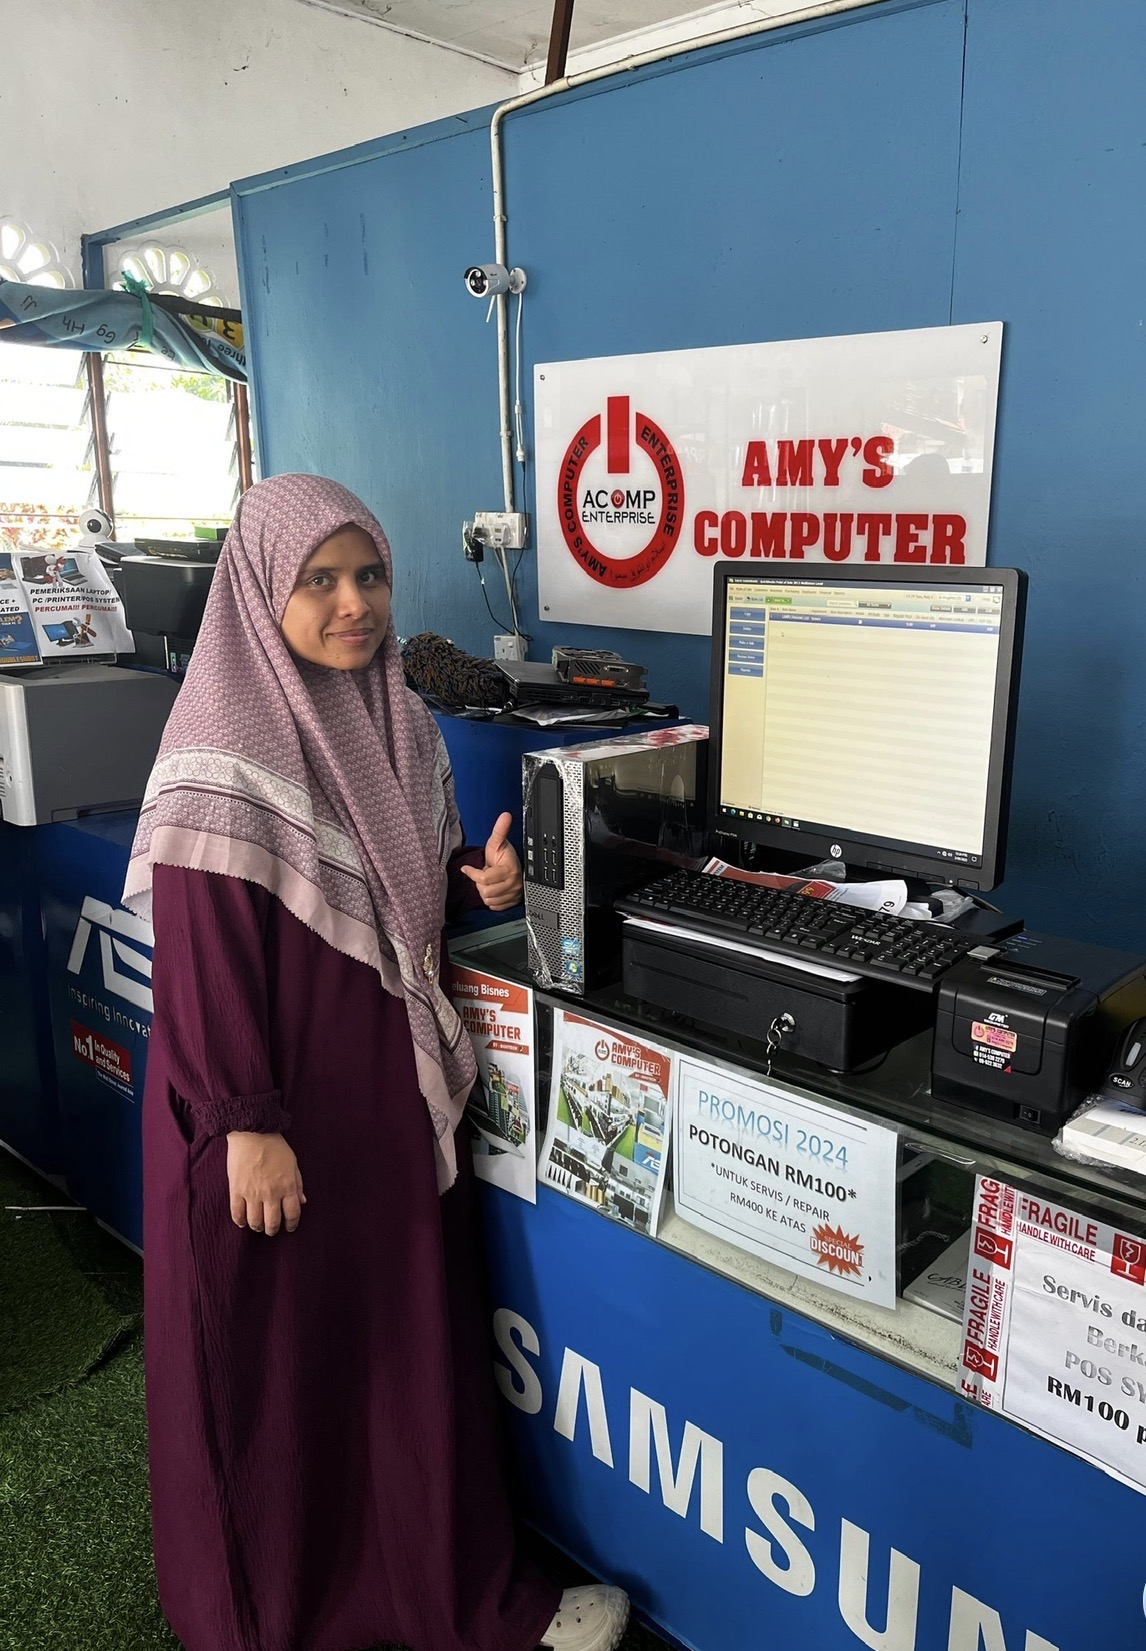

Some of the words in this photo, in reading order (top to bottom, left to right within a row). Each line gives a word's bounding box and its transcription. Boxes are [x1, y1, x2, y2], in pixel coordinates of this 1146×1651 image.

[62, 315, 85, 335] Hh
[97, 323, 116, 344] Gg
[640, 425, 678, 537] ENTERPRISE
[742, 436, 895, 489] AMY'S
[563, 436, 589, 534] COMPUTER
[582, 511, 655, 524] ENTERPRISE
[693, 510, 967, 565] COMPUTER
[573, 536, 608, 577] AMY'S
[30, 587, 85, 595] PEMERIKSAAN
[452, 981, 479, 996] eluang
[480, 984, 510, 998] Bisnes
[67, 982, 111, 1022] Inspiring
[113, 1005, 151, 1039] Innovat
[463, 1006, 497, 1022] AMY'S
[463, 1021, 522, 1040] COMPUTER
[100, 1044, 120, 1066] Quality
[611, 1054, 661, 1075] COMPUTER
[612, 1041, 641, 1058] AMY'S
[106, 1059, 130, 1083] Services
[1112, 1076, 1132, 1088] SCAN
[698, 1090, 789, 1145] PROMOSI
[796, 1129, 849, 1167] 2024
[689, 1124, 780, 1177] POTONGAN
[730, 1191, 764, 1215] RM400
[765, 1207, 778, 1222] KE
[780, 1214, 807, 1233] ATAS
[750, 1180, 783, 1203] SERVIS
[793, 1197, 830, 1222] REPAIR
[1016, 1220, 1049, 1243] HANDLE
[1049, 1233, 1071, 1251] WITH
[1071, 1242, 1096, 1263] CARE
[967, 1268, 991, 1346] FRAGILE
[994, 1278, 1006, 1301] CARE
[1043, 1274, 1112, 1319] Servis
[990, 1299, 1001, 1321] WITH
[987, 1319, 1000, 1352] HANDLE
[1065, 1350, 1112, 1387] POS
[1047, 1375, 1130, 1431] RM100
[493, 1307, 1146, 1651] SAMSU
